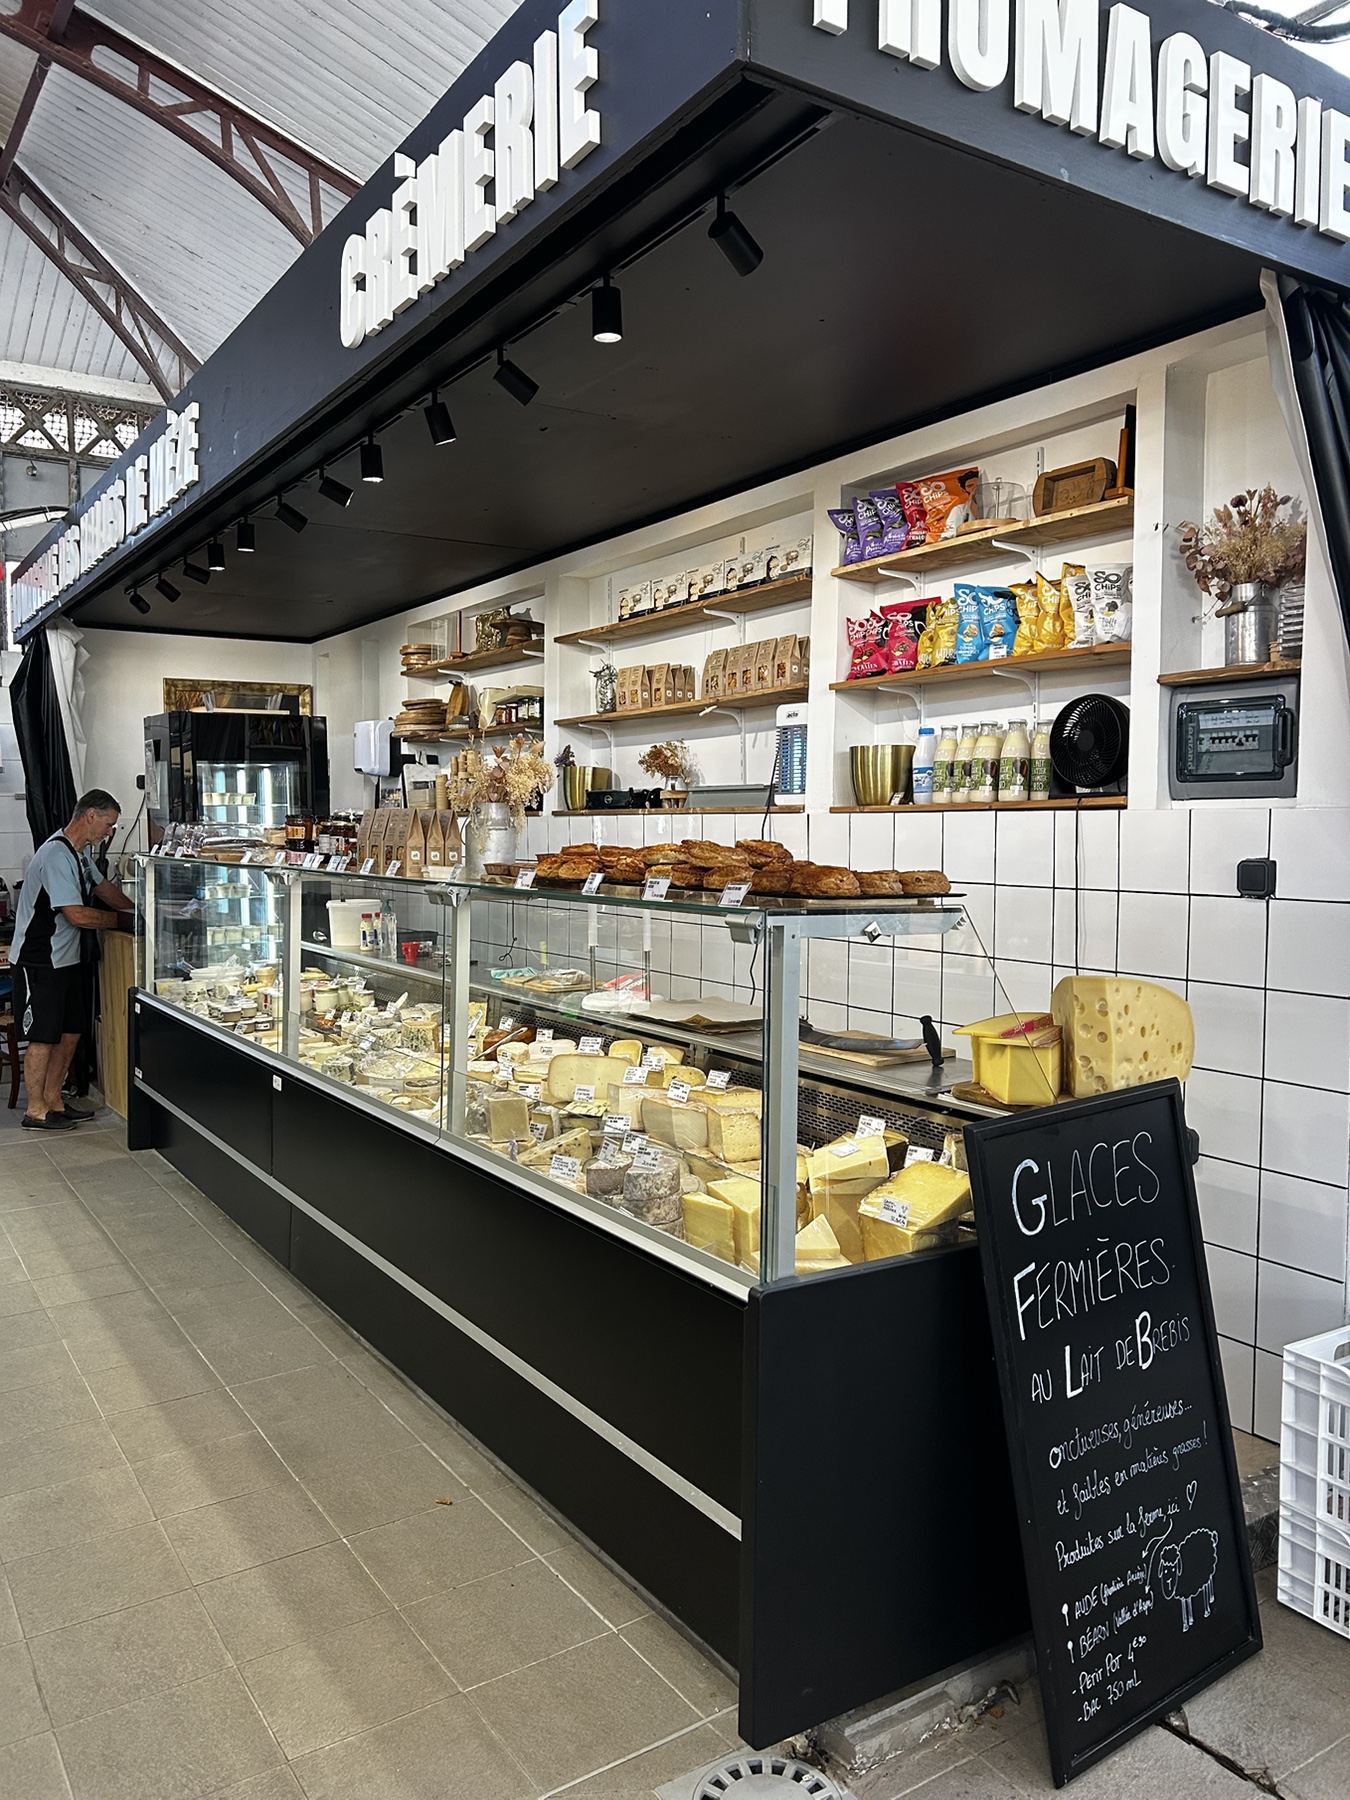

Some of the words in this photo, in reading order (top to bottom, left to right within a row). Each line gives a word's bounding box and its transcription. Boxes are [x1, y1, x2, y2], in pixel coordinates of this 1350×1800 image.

[811, 0, 1350, 242] OMAGERIE
[340, 0, 600, 349] CRÈMERIE
[1094, 571, 1122, 584] SO
[1012, 1131, 1160, 1236] GLACES
[1013, 1237, 1170, 1341] FERMIÈRES
[1031, 1370, 1053, 1403] AU
[1116, 1335, 1135, 1371] DE
[1057, 1488, 1069, 1515] et
[1072, 1469, 1111, 1520] faibles
[1115, 1469, 1128, 1487] en
[1055, 1531, 1104, 1571] Produites
[1108, 1525, 1124, 1544] sur
[1126, 1512, 1137, 1534] la
[1167, 1496, 1180, 1514] ici
[1074, 1585, 1098, 1620] AUDE
[1079, 1621, 1109, 1659] BÉARN
[1105, 1652, 1122, 1676] POT
